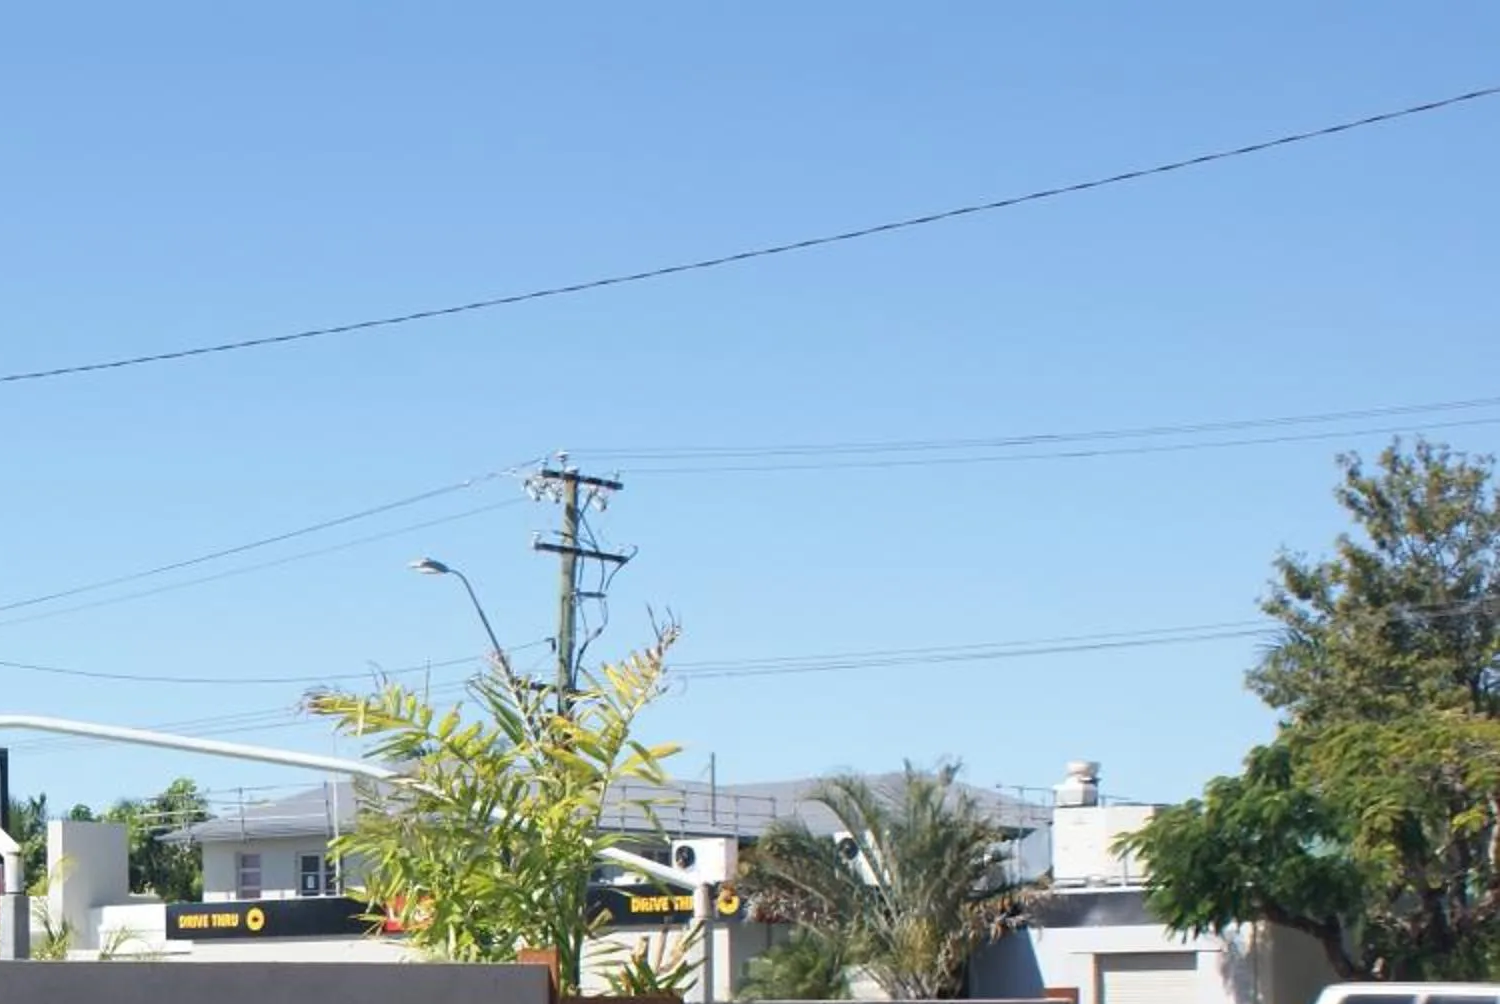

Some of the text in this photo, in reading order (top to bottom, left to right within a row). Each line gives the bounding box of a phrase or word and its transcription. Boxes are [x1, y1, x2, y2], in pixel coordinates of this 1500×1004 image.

[631, 895, 694, 913] DRIVE TH
[179, 913, 239, 929] DRIVE THRU
